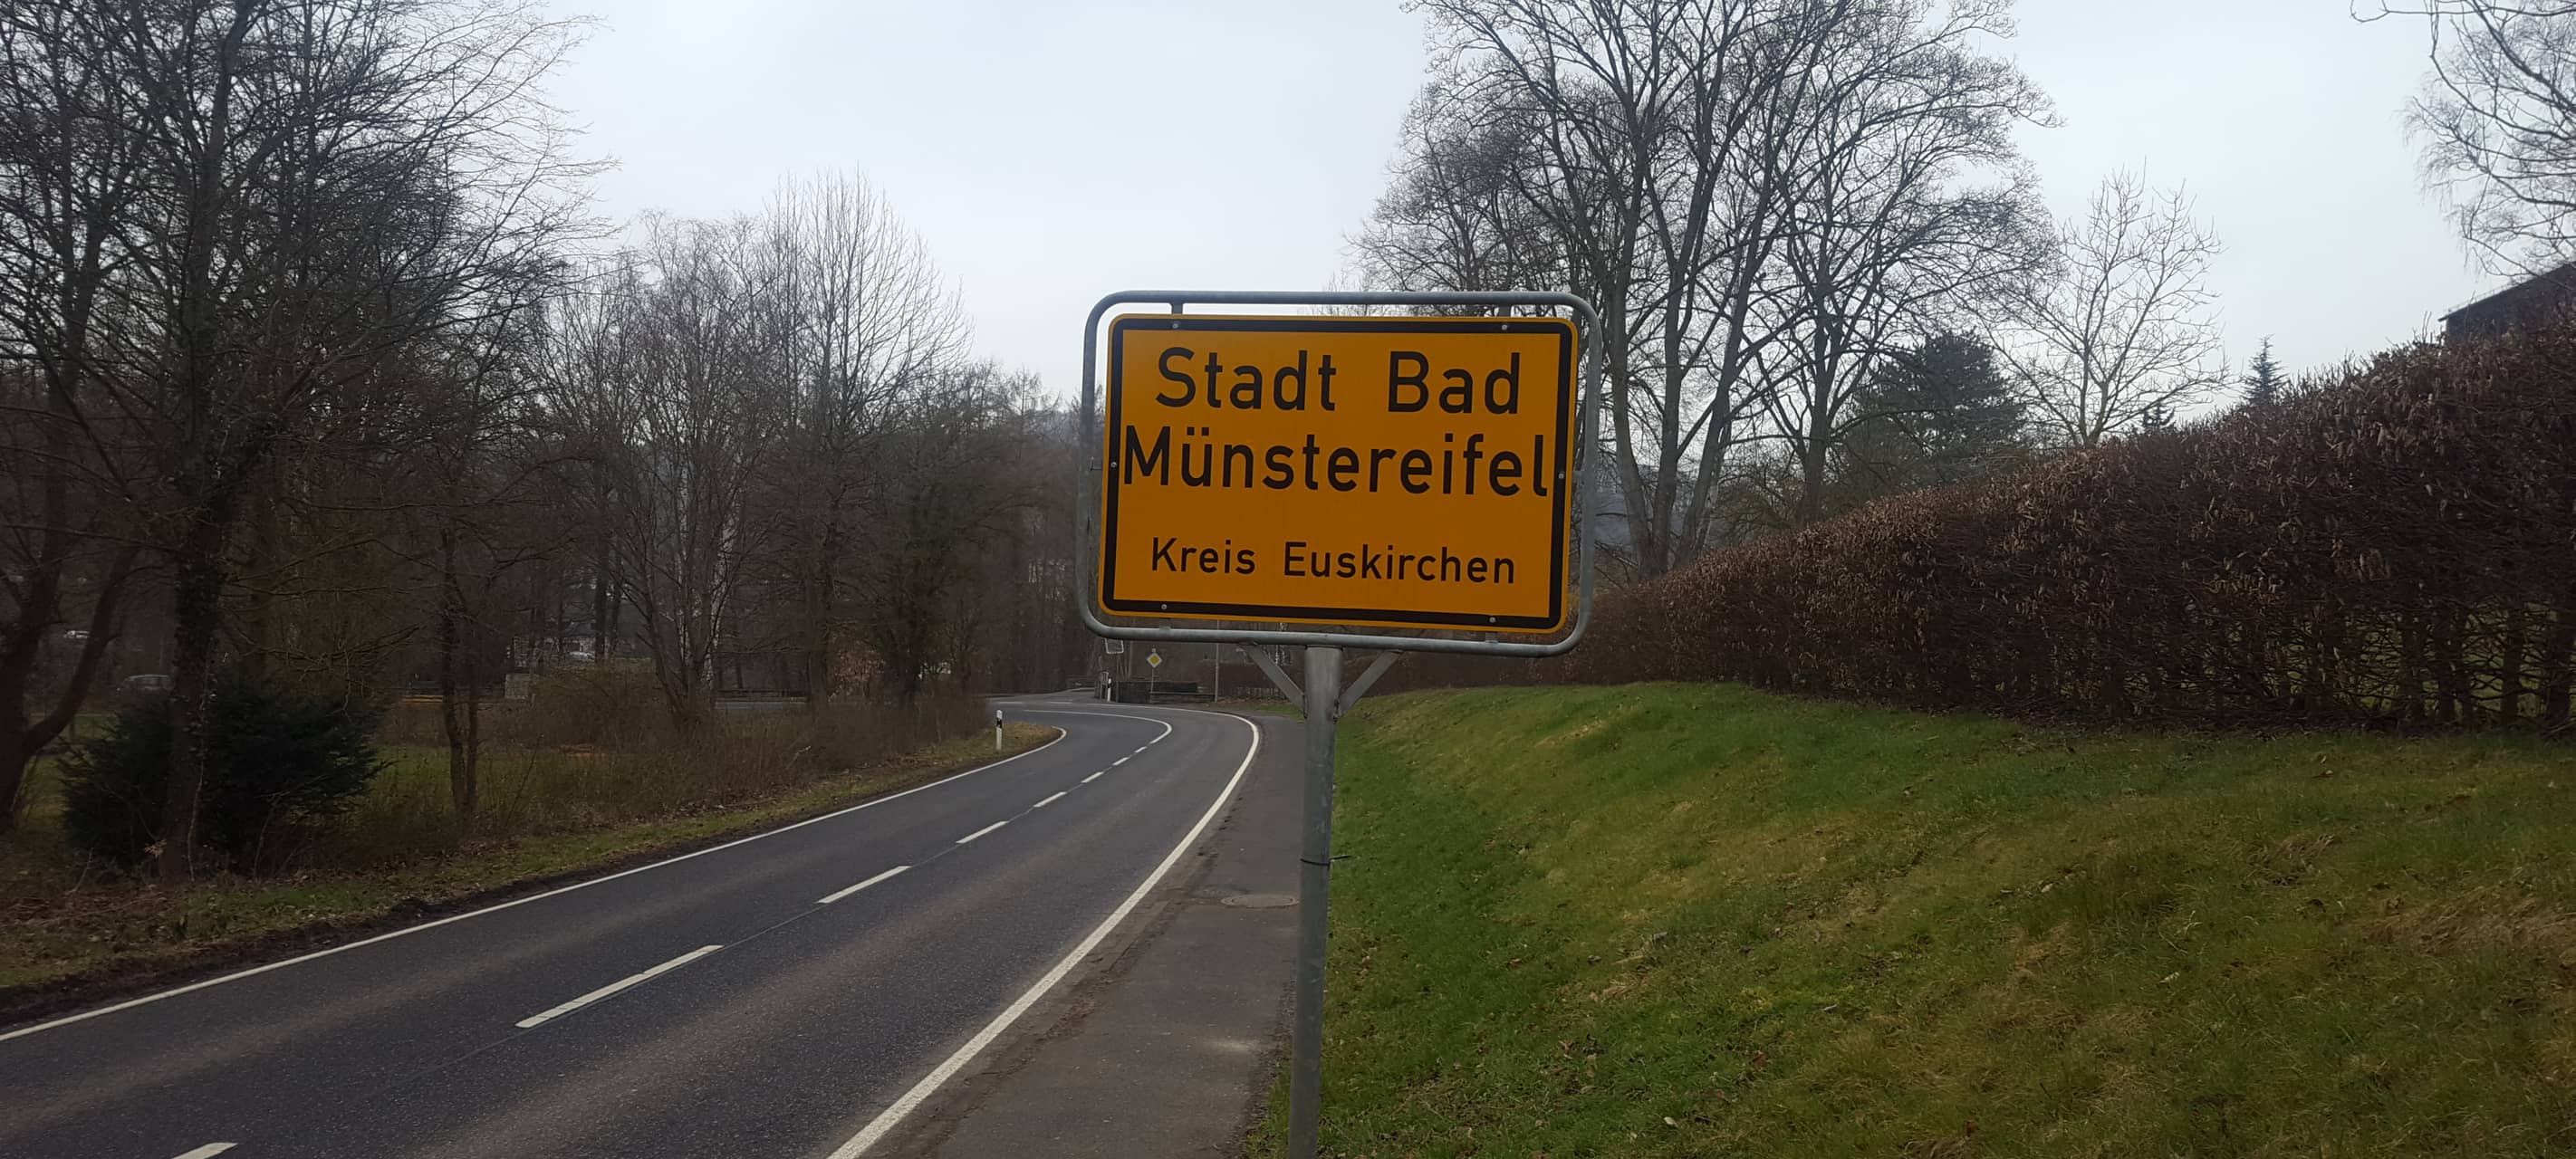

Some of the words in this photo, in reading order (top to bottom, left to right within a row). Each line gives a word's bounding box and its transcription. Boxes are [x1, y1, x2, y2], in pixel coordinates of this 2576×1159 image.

[1155, 347, 1337, 411] Stadt
[1388, 350, 1521, 415] Bad
[1123, 425, 1548, 497] Münstereifel
[1151, 537, 1255, 575] Kreis
[1283, 541, 1514, 584] Euskirchen
